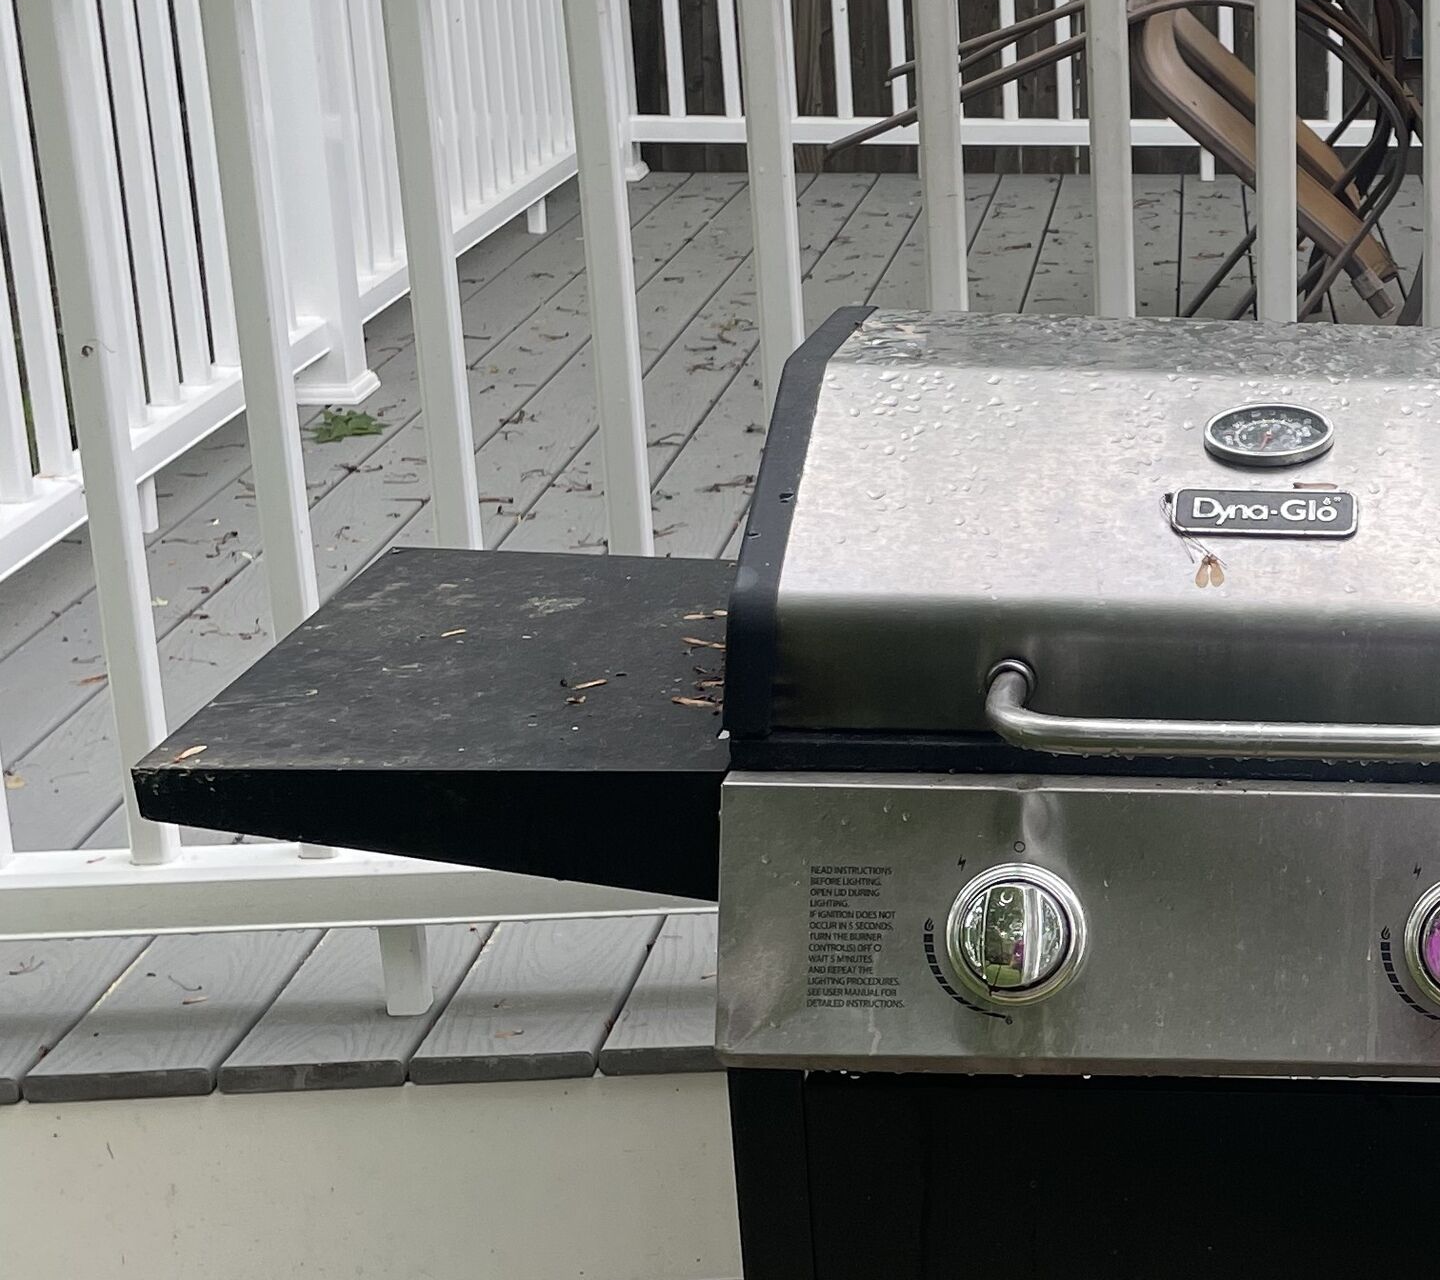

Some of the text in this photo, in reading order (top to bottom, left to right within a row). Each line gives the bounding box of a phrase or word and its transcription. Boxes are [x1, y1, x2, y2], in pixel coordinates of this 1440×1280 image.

[810, 866, 892, 875] READ INSTRUCTIONS
[810, 877, 841, 885] BEFORE
[810, 888, 880, 897] OPEN LID DURING
[818, 911, 854, 919] IGNITION
[855, 911, 877, 919] DOES
[878, 911, 896, 919] NOT
[809, 922, 837, 930] OCCUR
[838, 922, 847, 930] IN
[809, 933, 882, 941] TURN THE BURNER
[857, 944, 872, 952] OFF
[809, 955, 829, 963] WAIT
[808, 966, 873, 974] AND REPEAT THE
[807, 977, 845, 985] LIGHTING
[807, 988, 897, 997] SEE USER MANUAL FOR
[807, 999, 844, 1007] DETAILED
